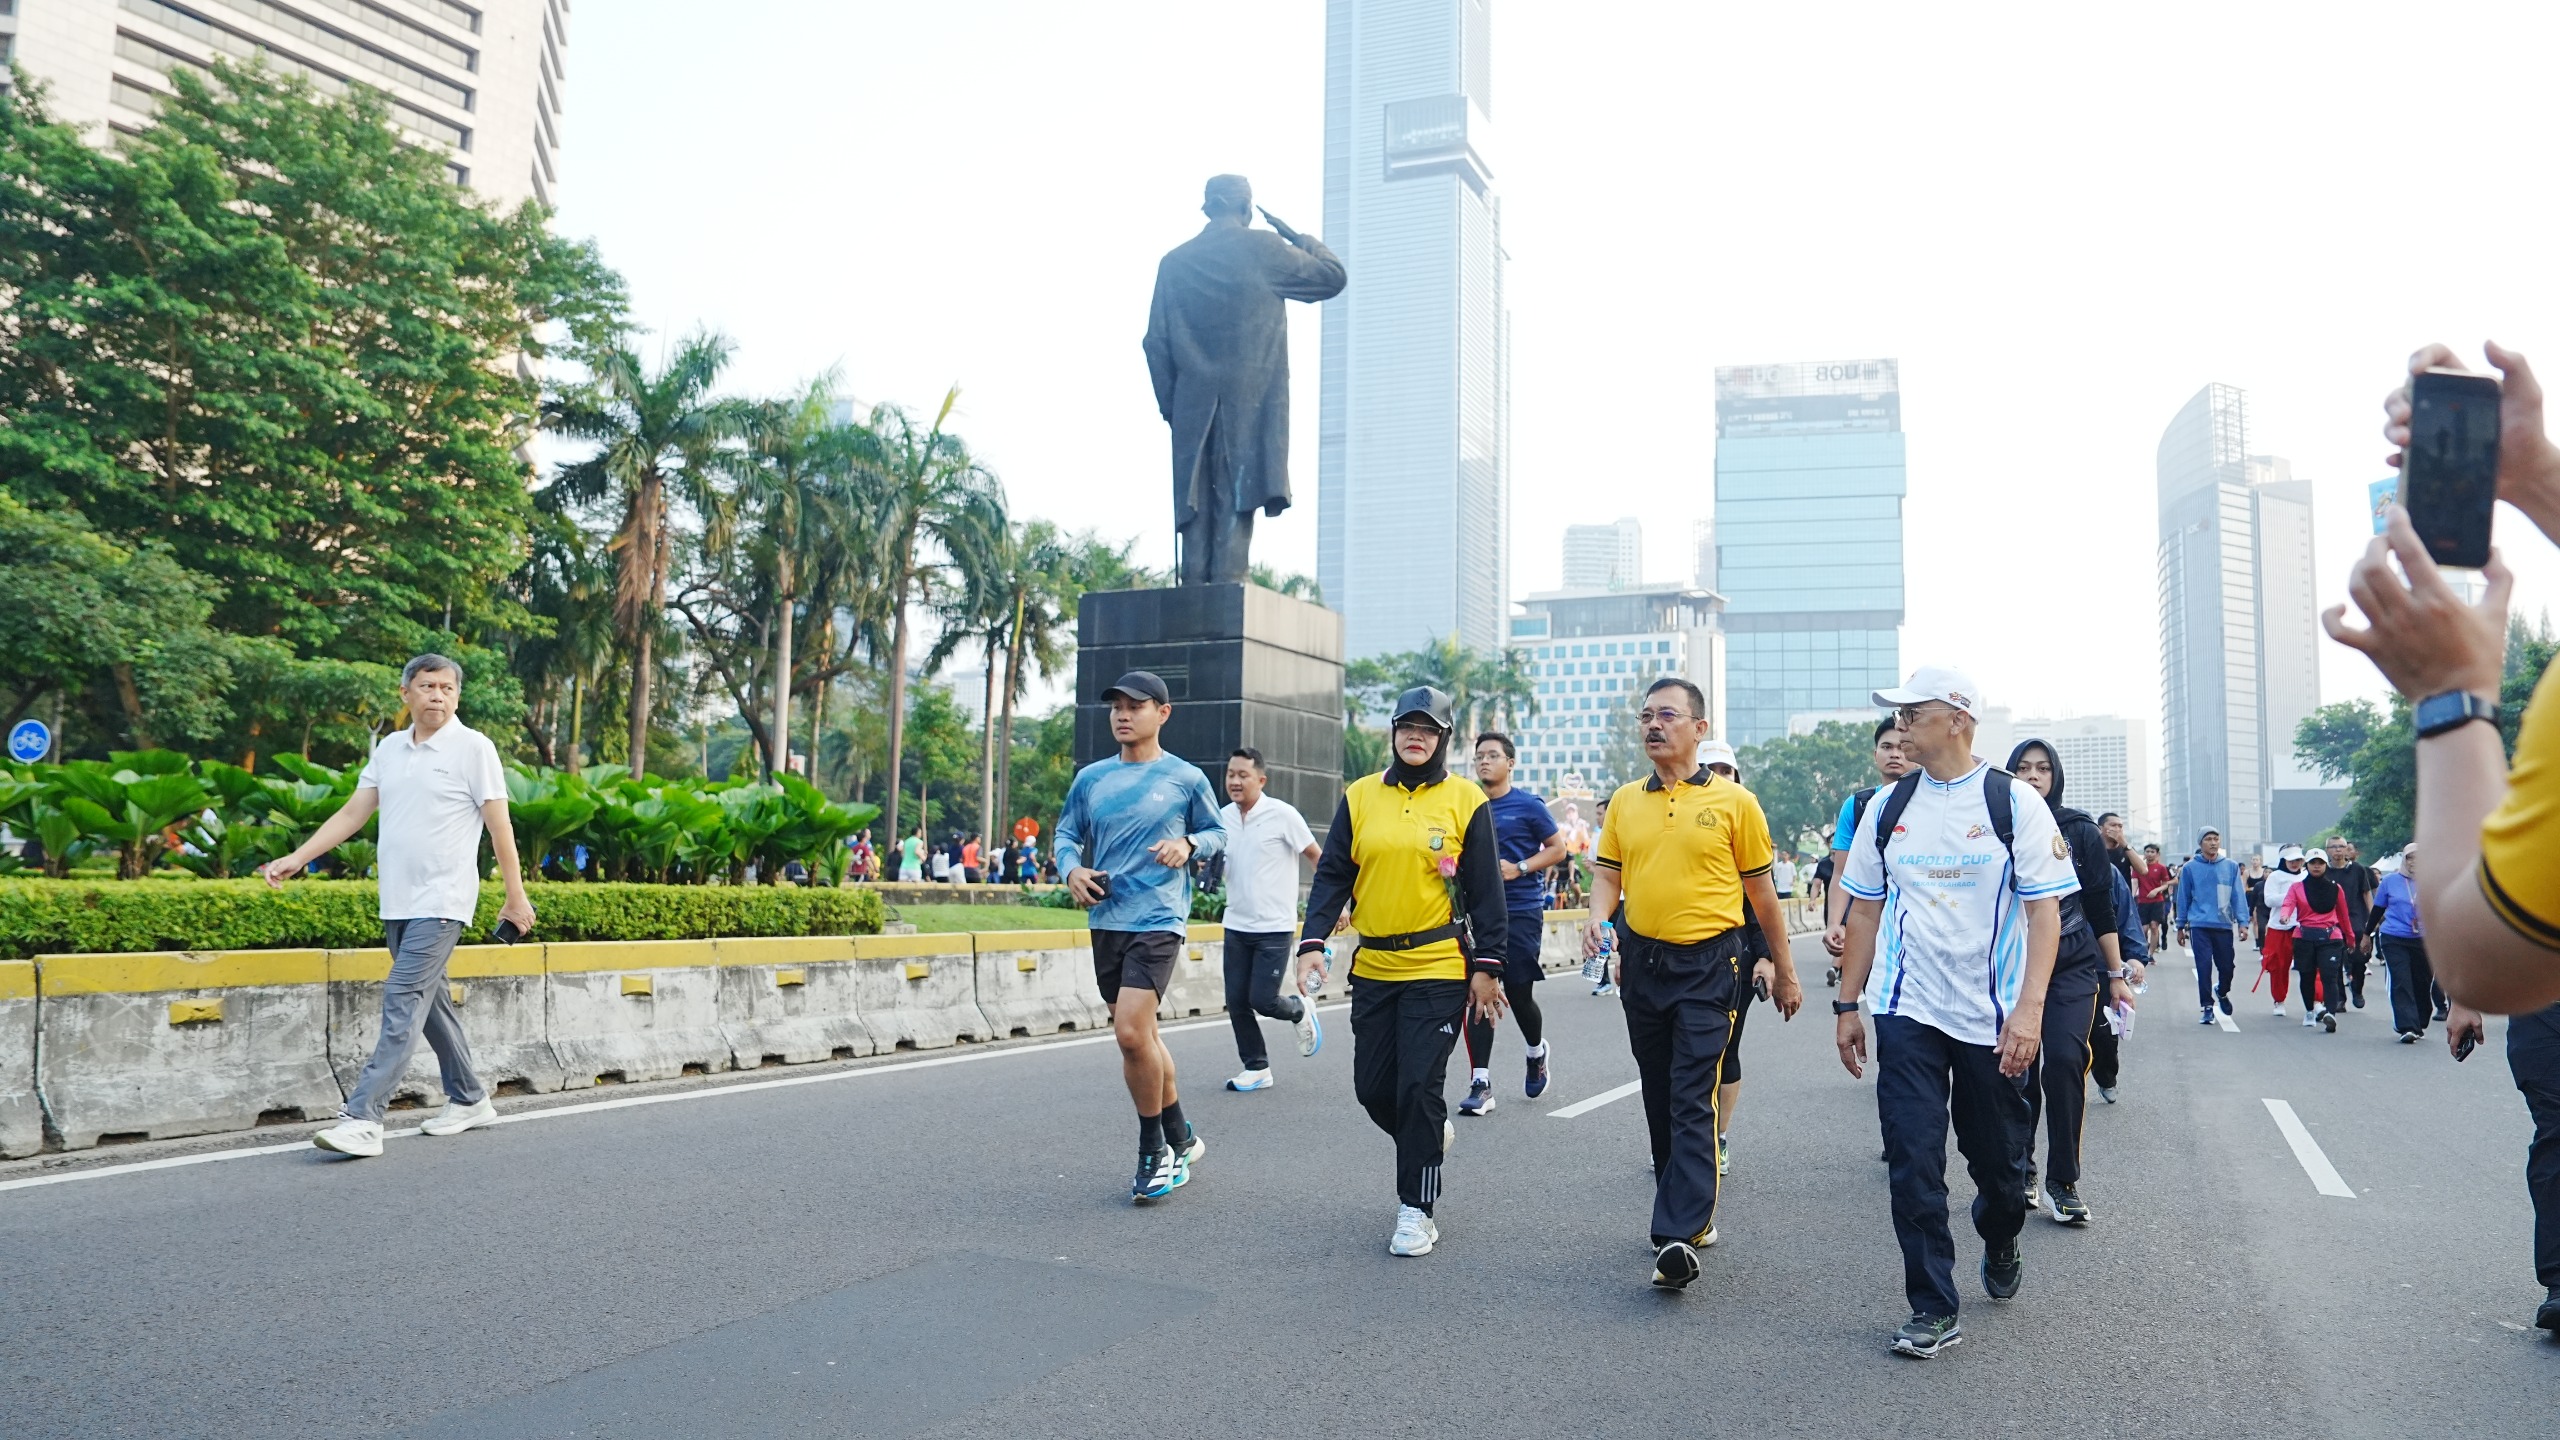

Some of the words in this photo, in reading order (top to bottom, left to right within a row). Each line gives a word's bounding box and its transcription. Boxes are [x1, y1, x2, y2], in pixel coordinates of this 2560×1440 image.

[1897, 854, 1957, 866] KAPOLRI
[1961, 854, 1993, 865] CUP
[1927, 869, 1961, 879] 2026
